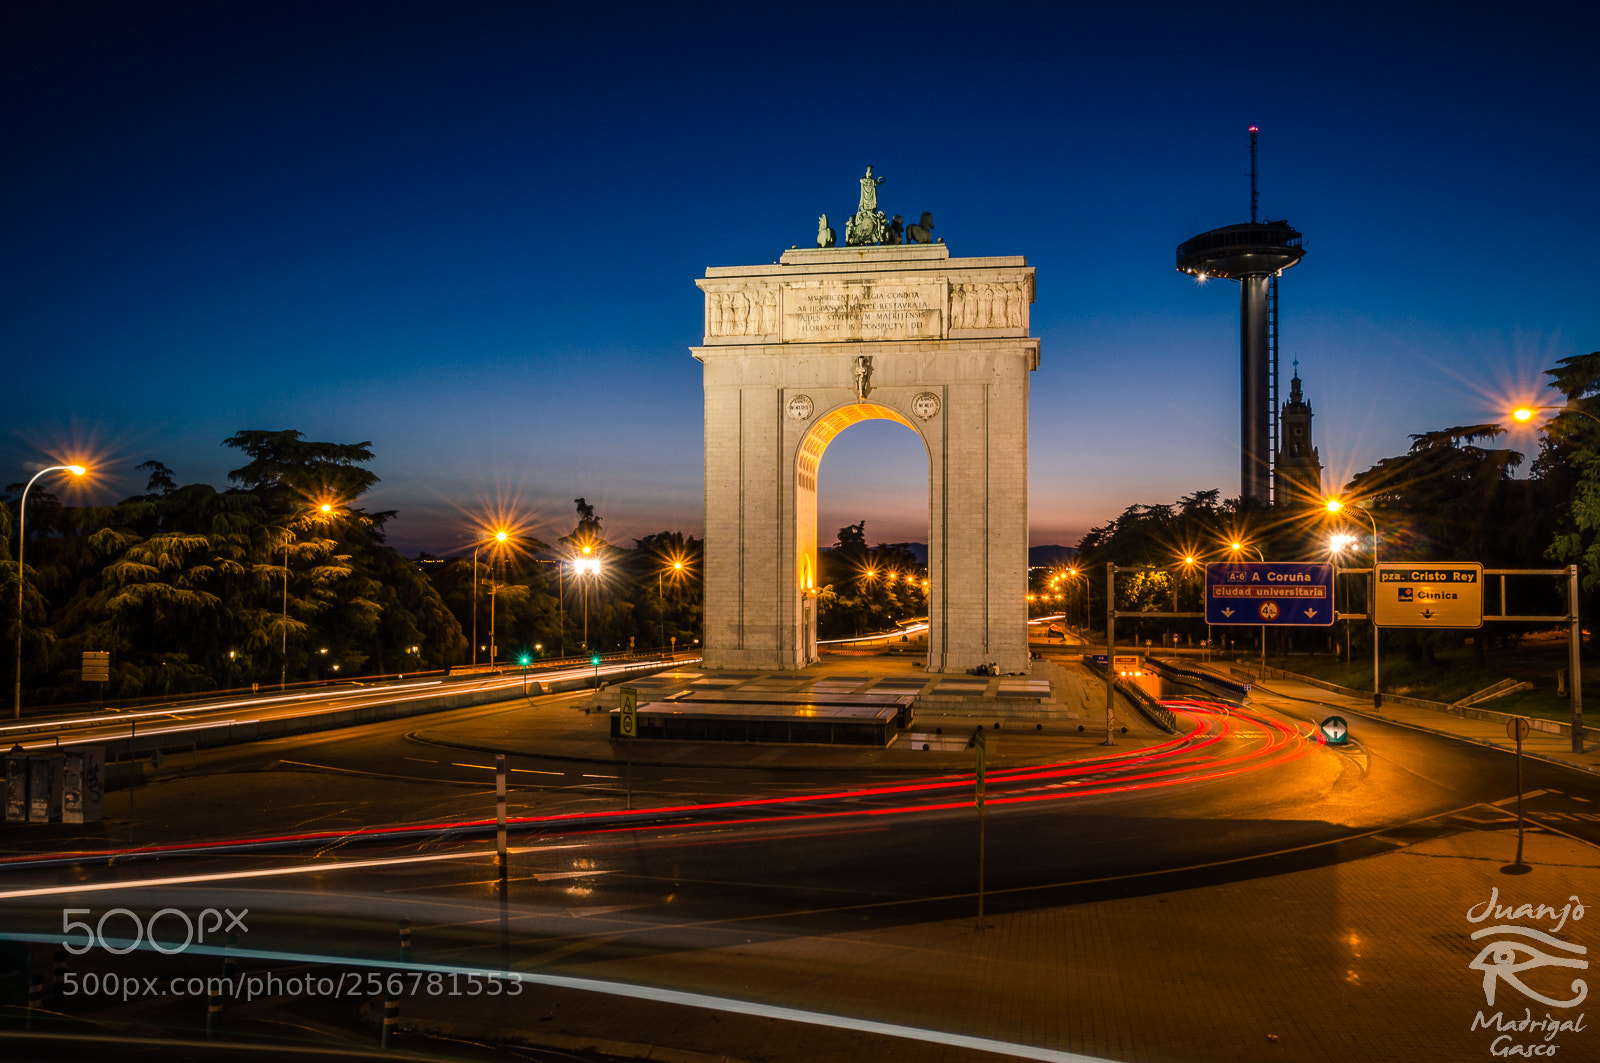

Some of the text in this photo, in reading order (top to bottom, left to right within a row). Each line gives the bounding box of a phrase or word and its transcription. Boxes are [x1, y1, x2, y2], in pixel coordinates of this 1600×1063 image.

[1229, 572, 1311, 582] A-6 A Coruña
[1382, 571, 1474, 582] pza. Cristo Rey
[1216, 587, 1323, 596] ciudad universitaria
